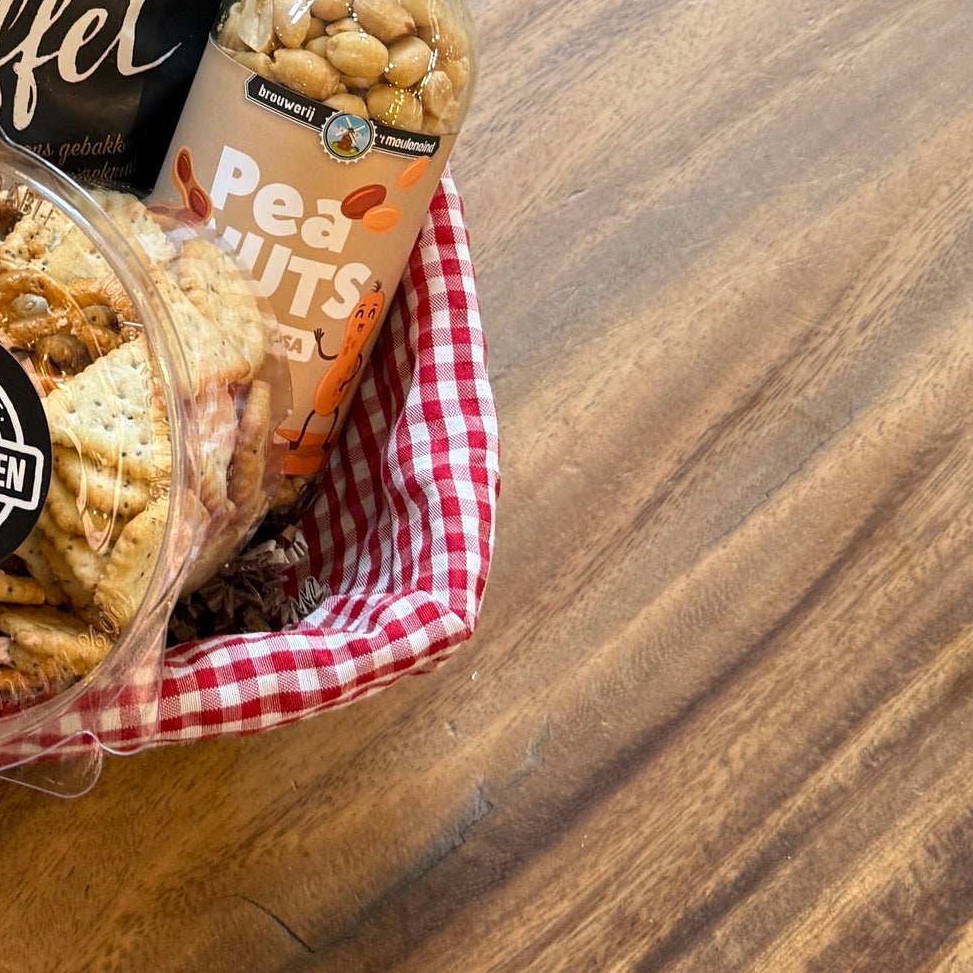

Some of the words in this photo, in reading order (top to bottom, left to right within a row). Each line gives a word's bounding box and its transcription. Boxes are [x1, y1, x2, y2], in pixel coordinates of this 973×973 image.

[258, 83, 316, 122] brouwerij
[385, 136, 436, 154] meuleneind
[209, 145, 353, 255] Pea
